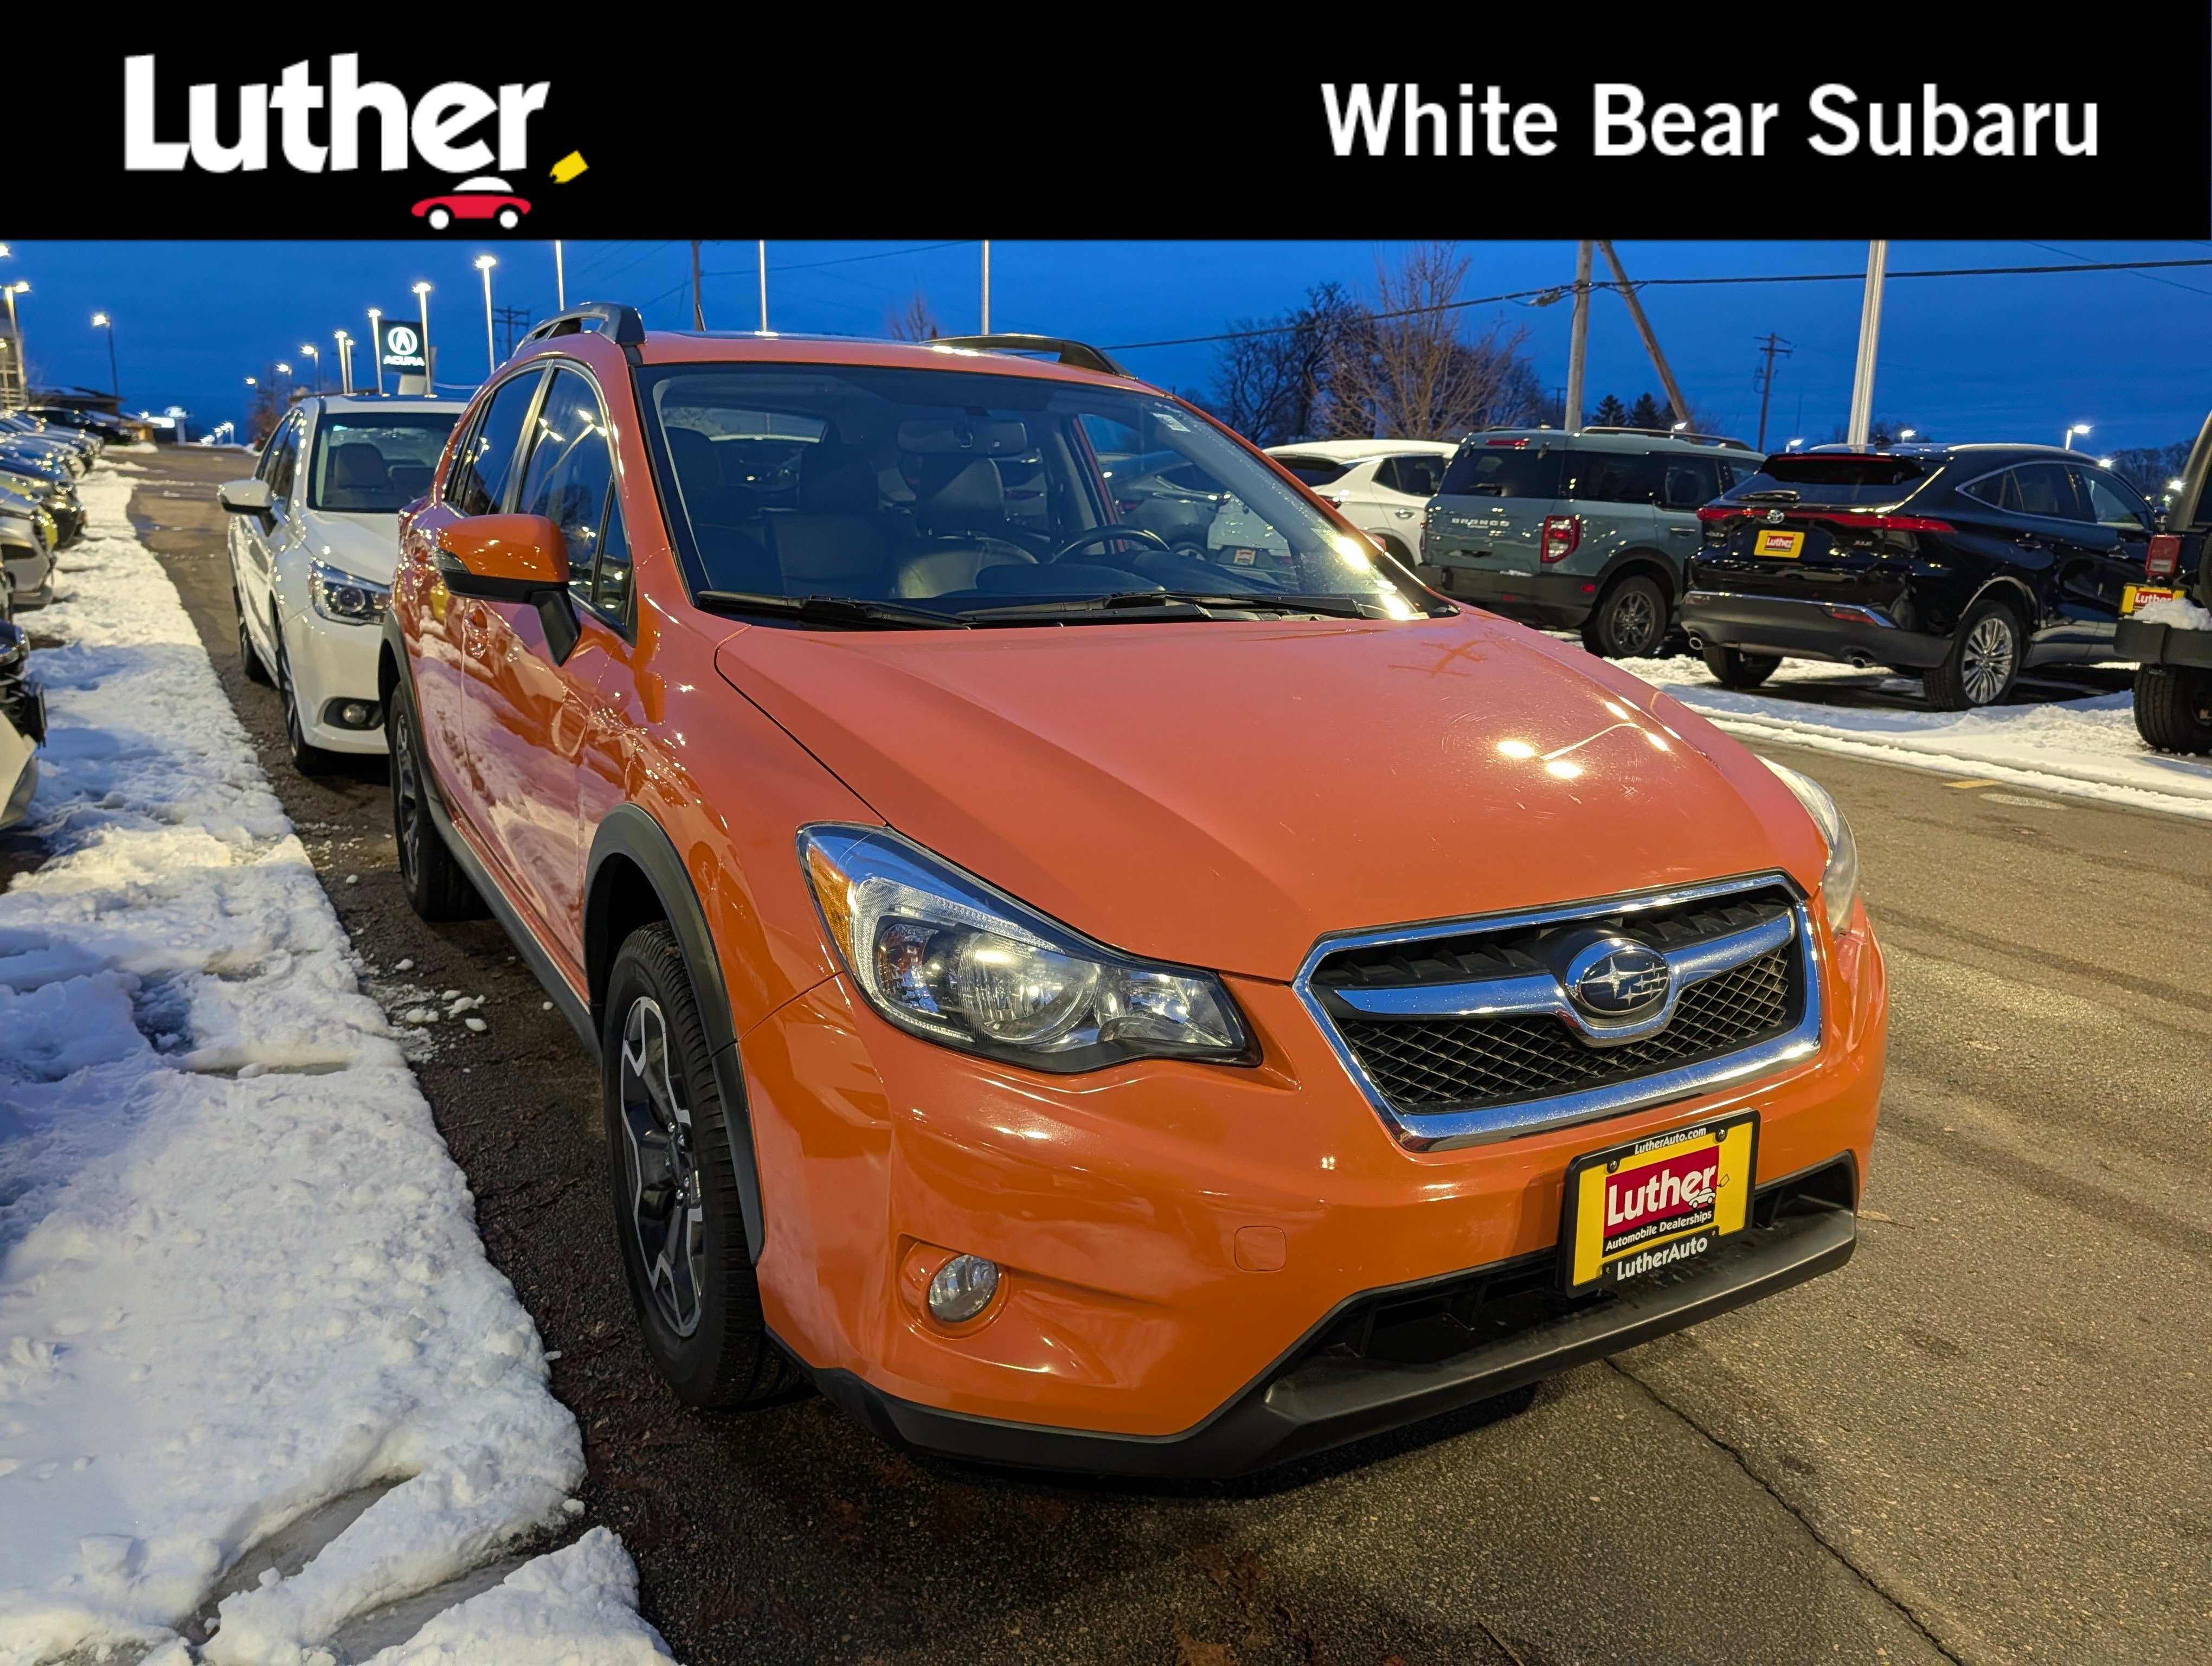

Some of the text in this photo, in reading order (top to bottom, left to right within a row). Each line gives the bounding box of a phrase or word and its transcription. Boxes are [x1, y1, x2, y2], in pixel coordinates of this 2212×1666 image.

[383, 355, 425, 366] ACURA
[1635, 1127, 1706, 1155] LutherAuto.com
[1608, 1165, 1716, 1226] Luther
[1605, 1210, 1712, 1252] Automobile Dealerships
[1617, 1236, 1708, 1281] LutherAuto
